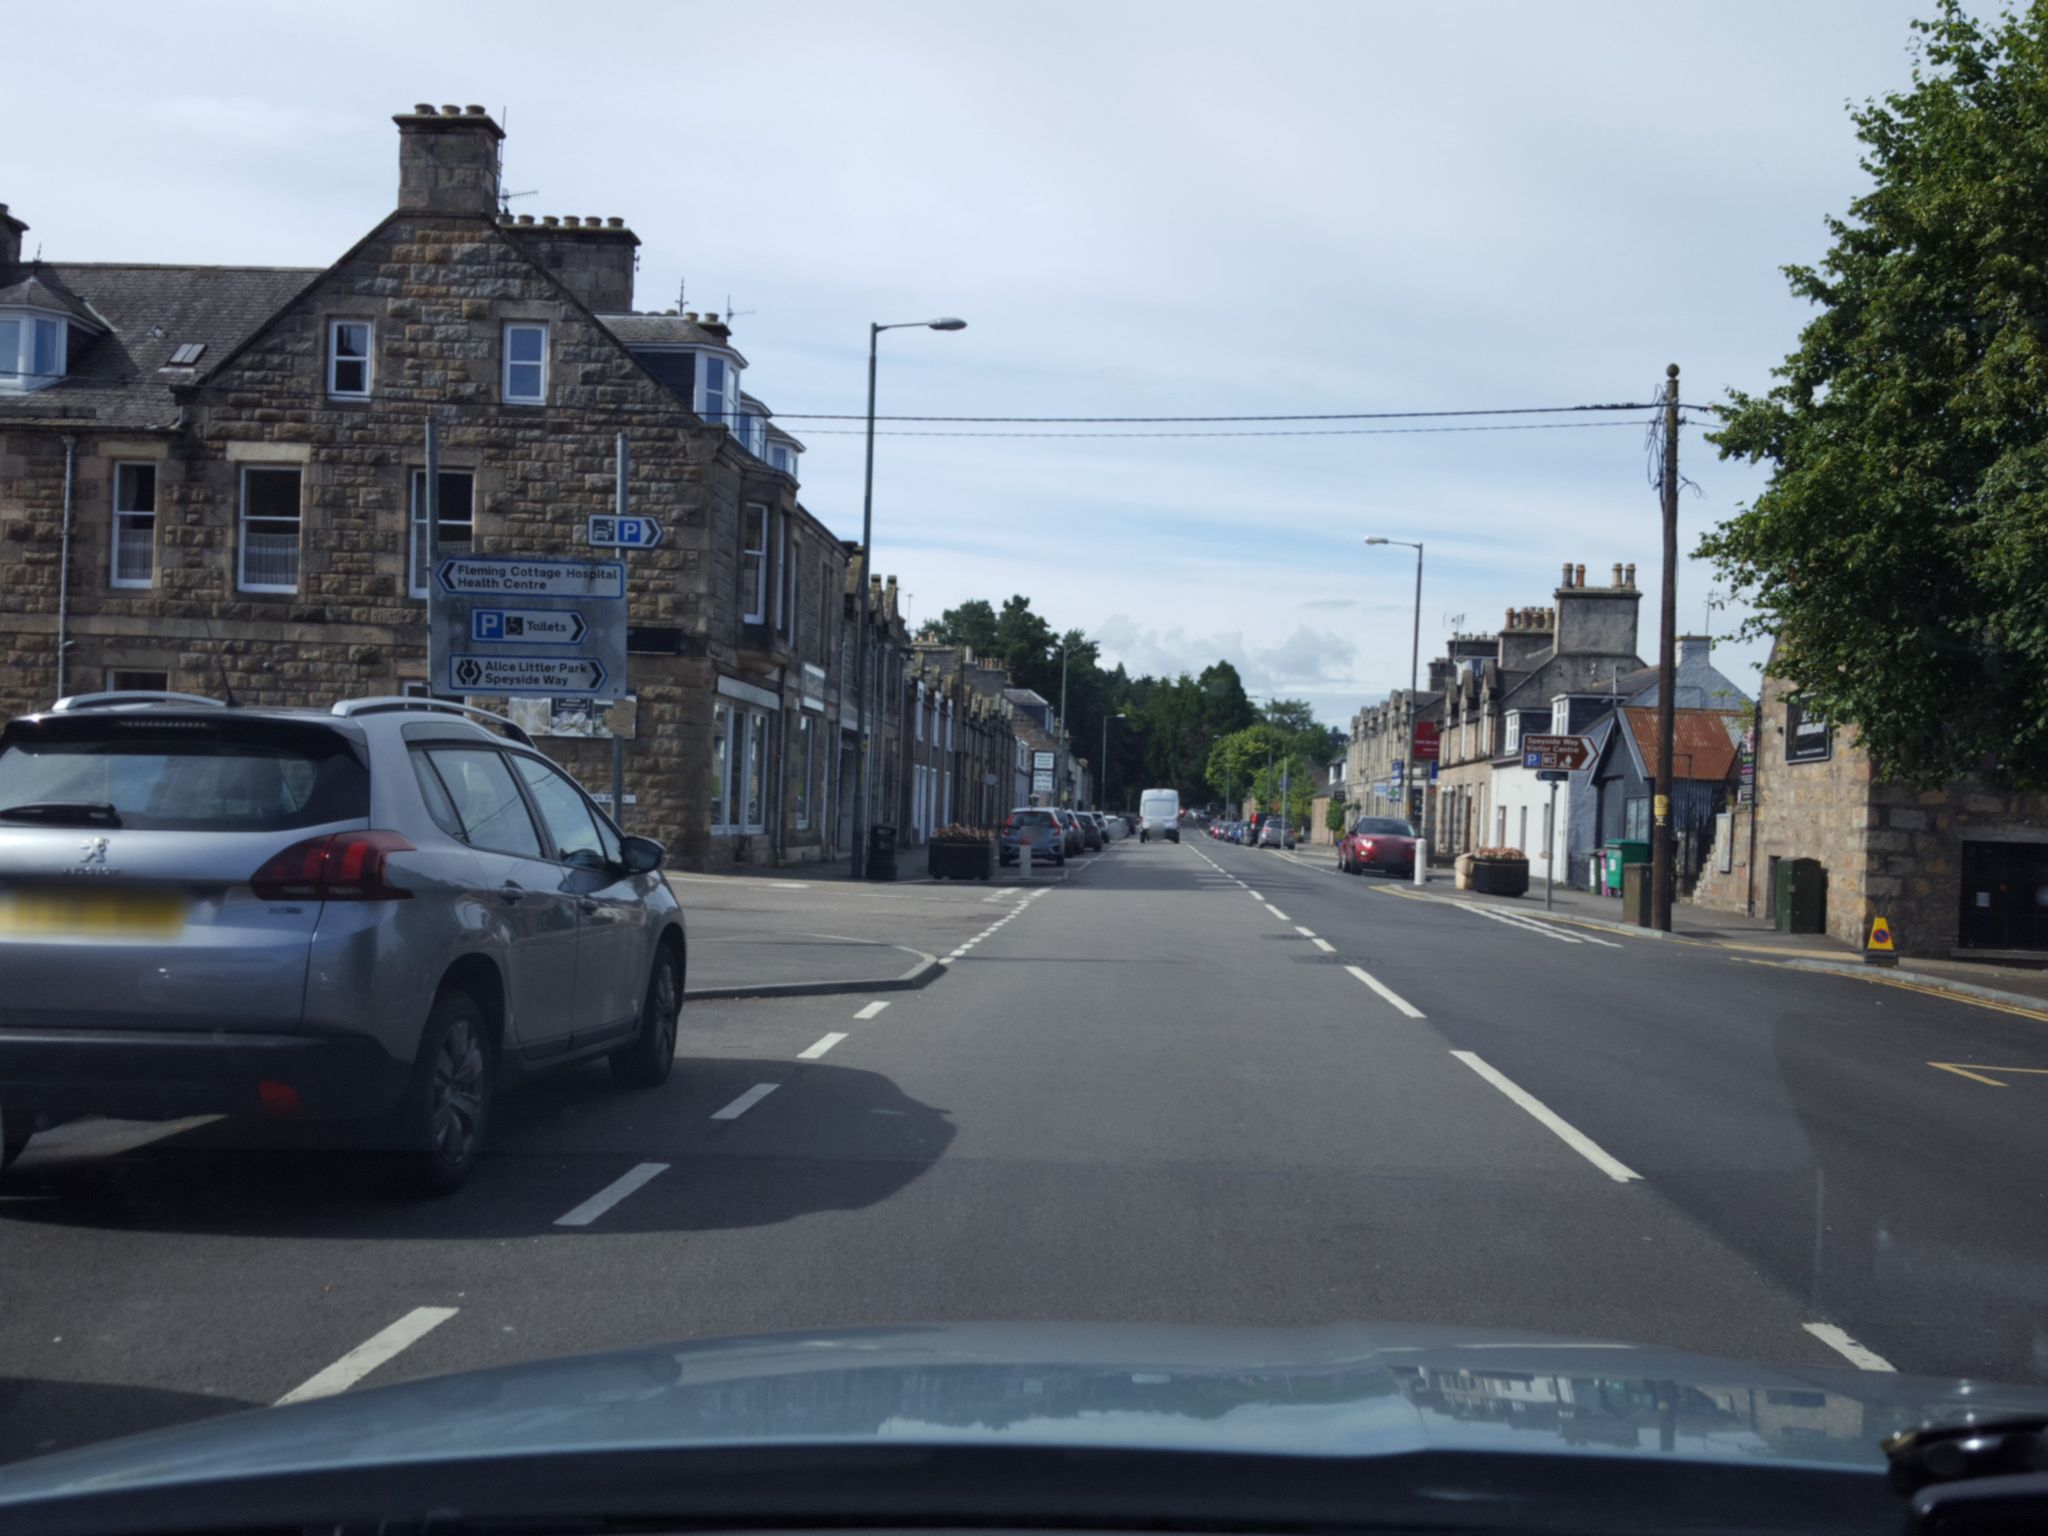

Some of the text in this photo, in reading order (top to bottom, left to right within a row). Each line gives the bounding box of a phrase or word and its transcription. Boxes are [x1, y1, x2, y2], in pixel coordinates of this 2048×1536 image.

[623, 522, 638, 541] P
[457, 565, 618, 581] Fleming Cottage Hospital
[457, 577, 546, 590] Health Centre
[481, 614, 567, 636] P Toilets
[485, 661, 588, 673] Alice Littler Park
[485, 673, 569, 687] Speyside Way
[1526, 744, 1579, 753] Visitor Centre
[1527, 737, 1579, 747] Speyside Way
